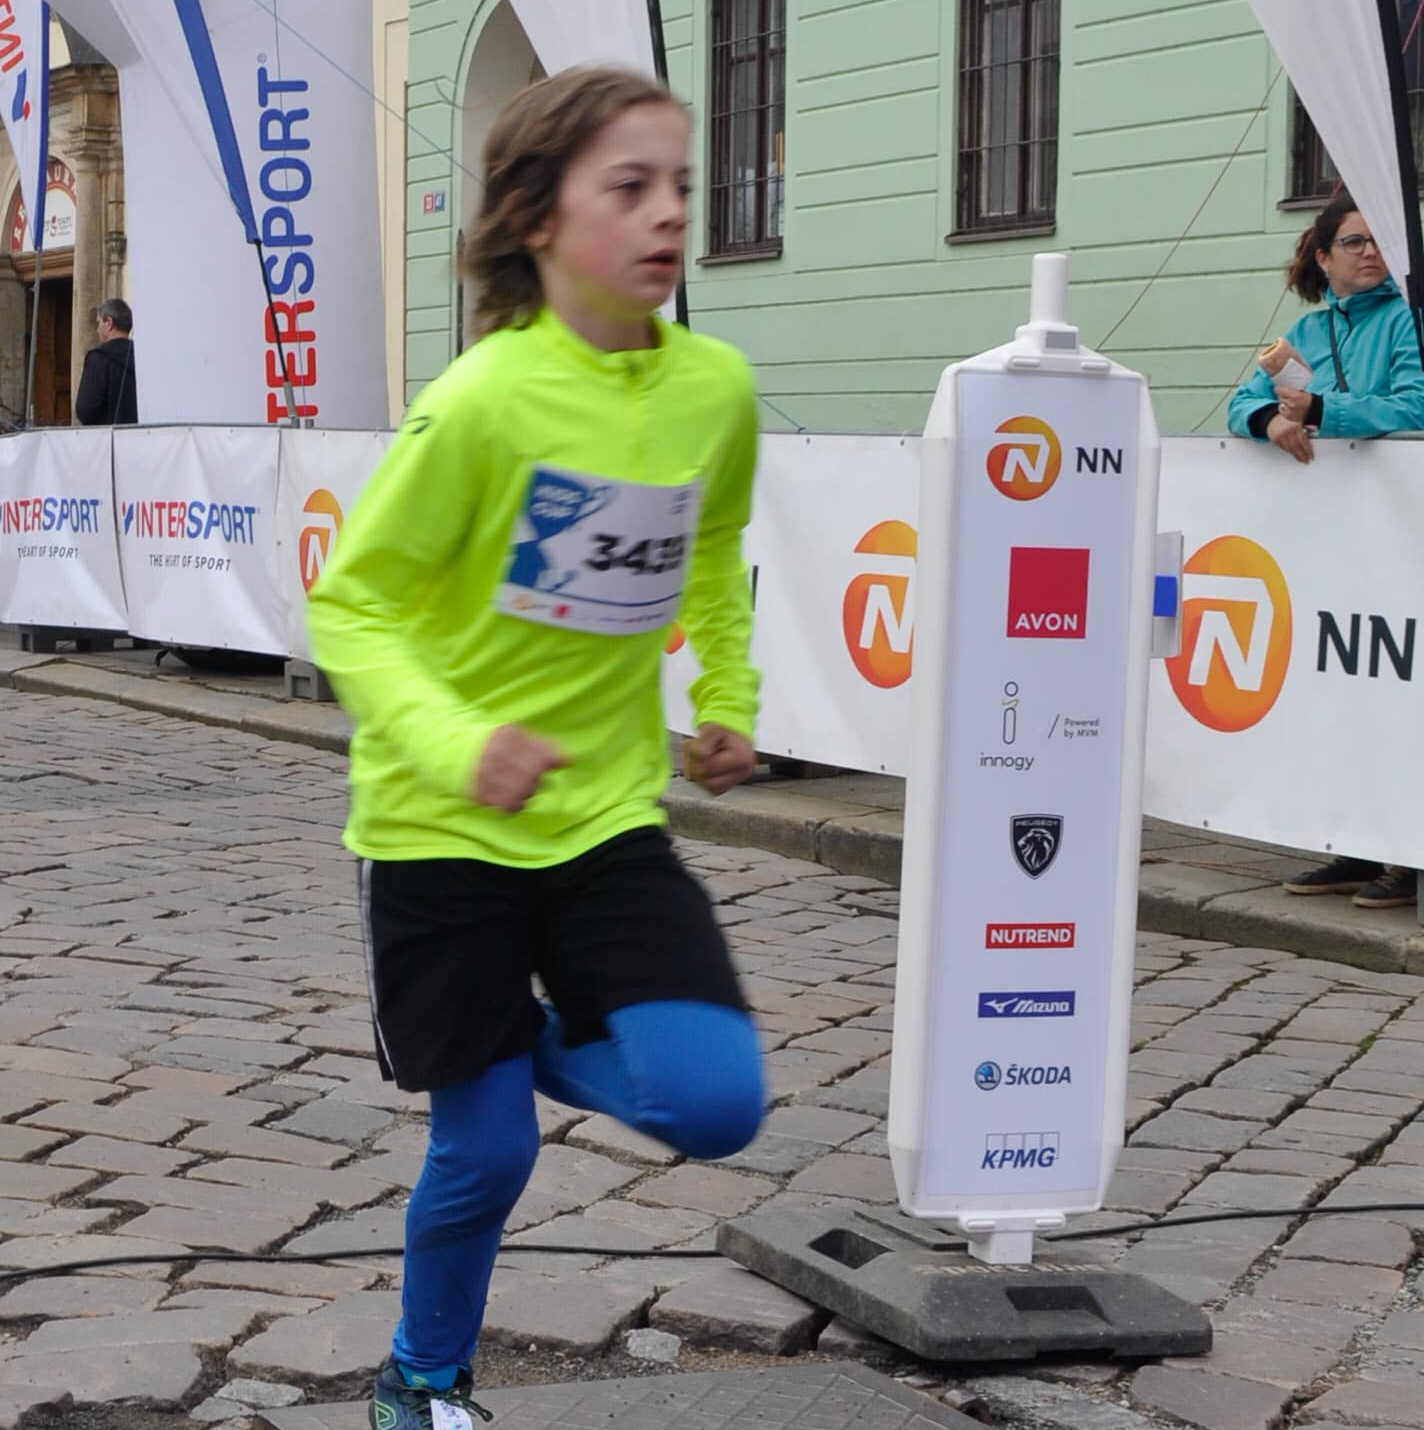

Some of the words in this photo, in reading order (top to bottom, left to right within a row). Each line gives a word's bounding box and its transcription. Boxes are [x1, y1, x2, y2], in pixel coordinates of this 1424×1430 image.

[1076, 447, 1123, 474] NN
[3, 496, 100, 535] INTERSPORT
[137, 500, 257, 545] INTERSPORT
[194, 556, 232, 572] SPORT
[1015, 612, 1078, 632] AVON
[1317, 609, 1417, 682] NN
[980, 752, 1035, 771] innogy
[990, 927, 1072, 945] NUTREND
[1006, 1062, 1072, 1087] ŠKODA
[981, 1147, 1057, 1170] KPMG
